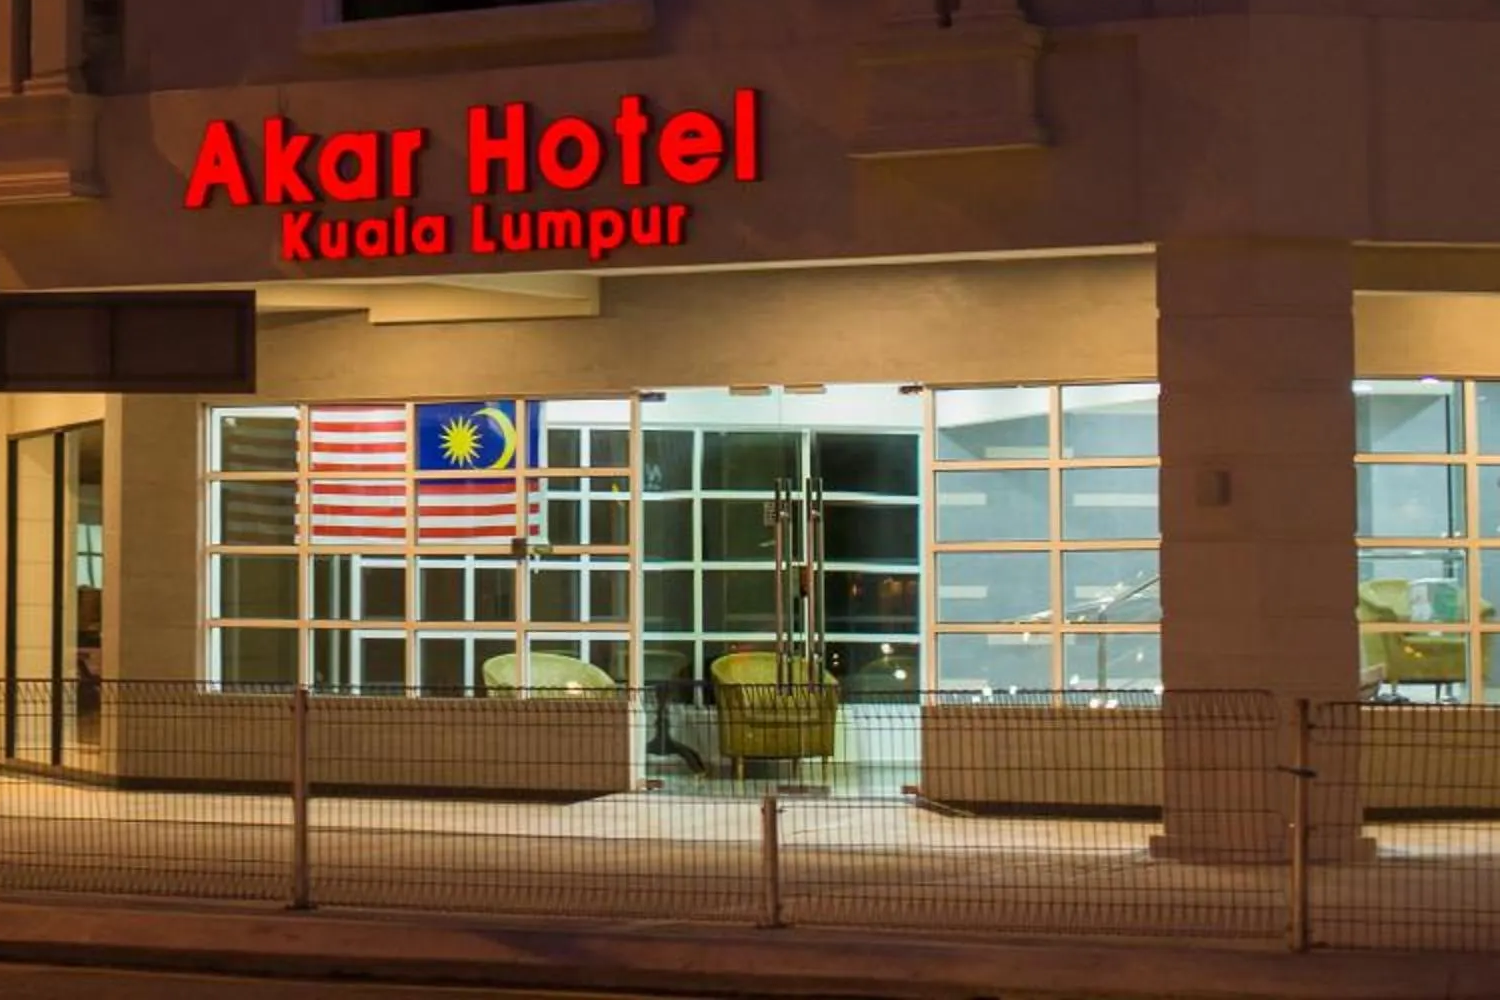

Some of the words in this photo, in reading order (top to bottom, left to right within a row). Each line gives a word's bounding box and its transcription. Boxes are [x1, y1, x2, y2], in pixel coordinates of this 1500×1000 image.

[185, 118, 424, 208] Akar
[468, 89, 756, 194] Hotel
[281, 206, 448, 261] Kuala
[471, 204, 687, 259] Lumpur
